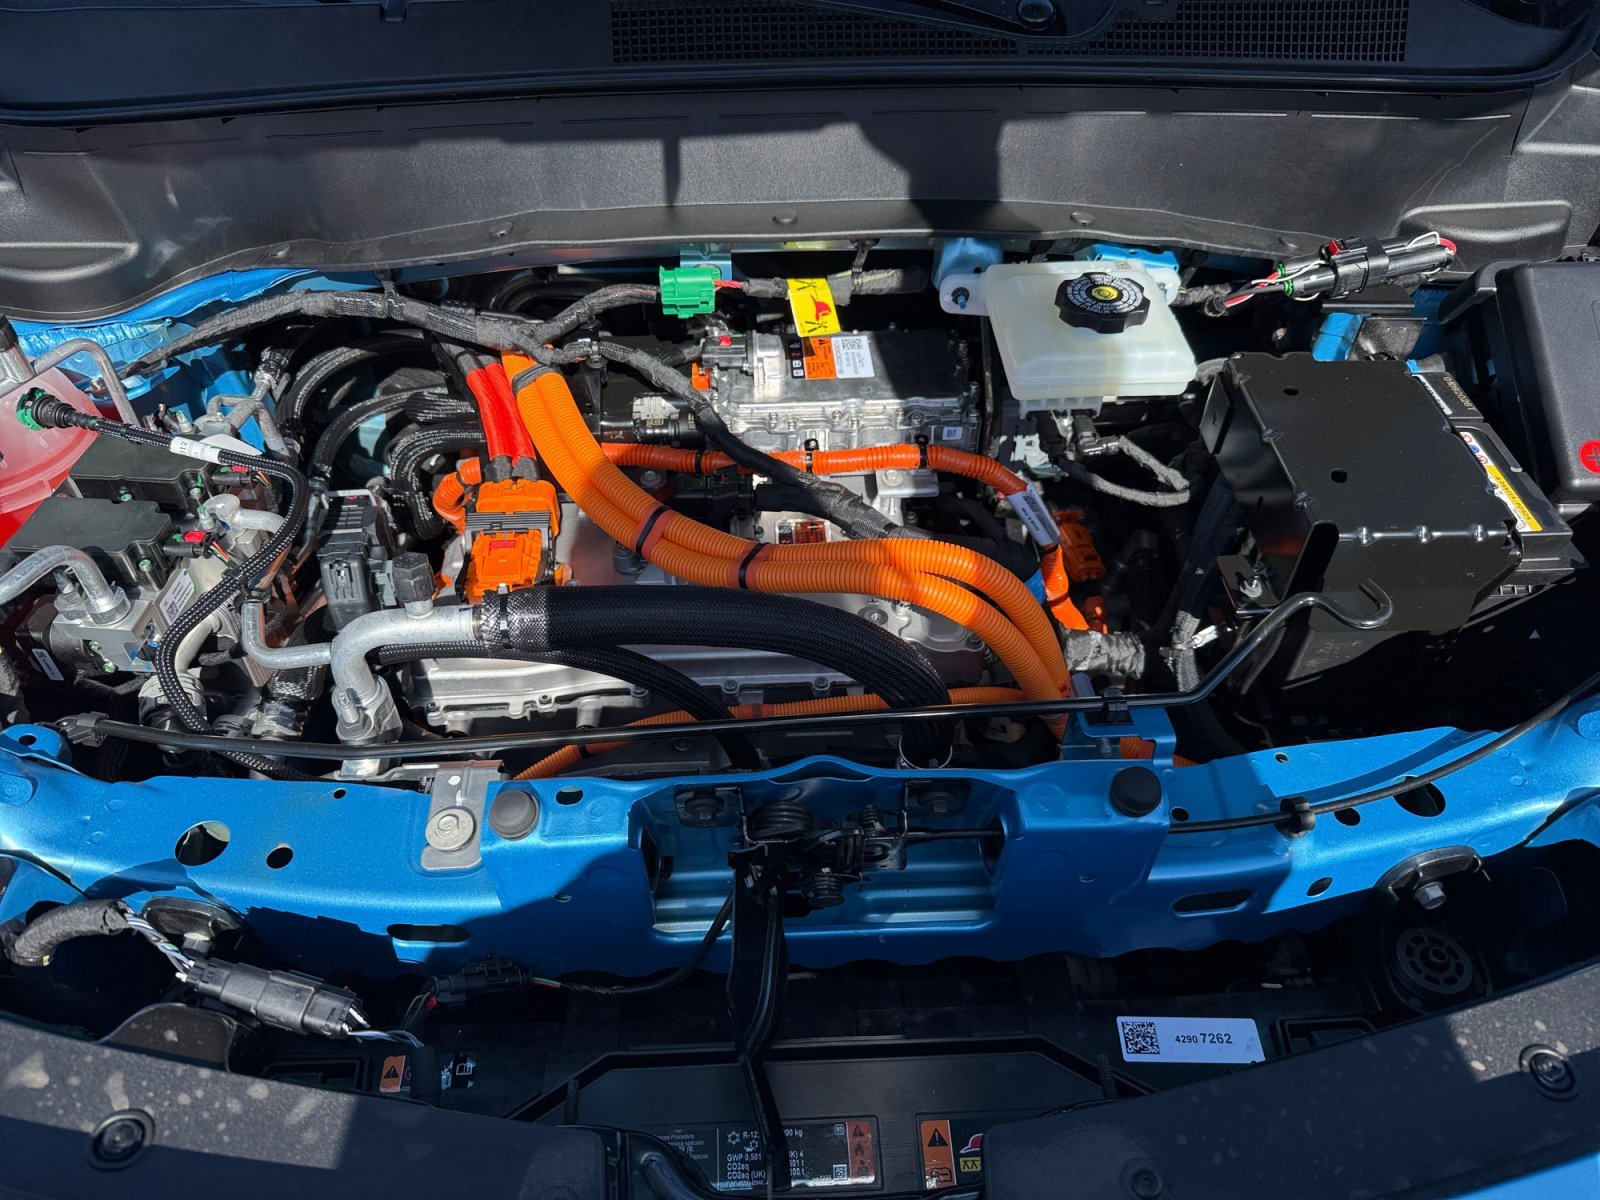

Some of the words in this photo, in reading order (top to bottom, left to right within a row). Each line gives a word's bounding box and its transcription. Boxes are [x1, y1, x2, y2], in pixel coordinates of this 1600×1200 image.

[1174, 1034, 1198, 1044] 4290
[1199, 1032, 1233, 1045] 7262
[794, 1128, 803, 1138] kg
[727, 1153, 744, 1162] GWP
[750, 1170, 766, 1180] (UK)
